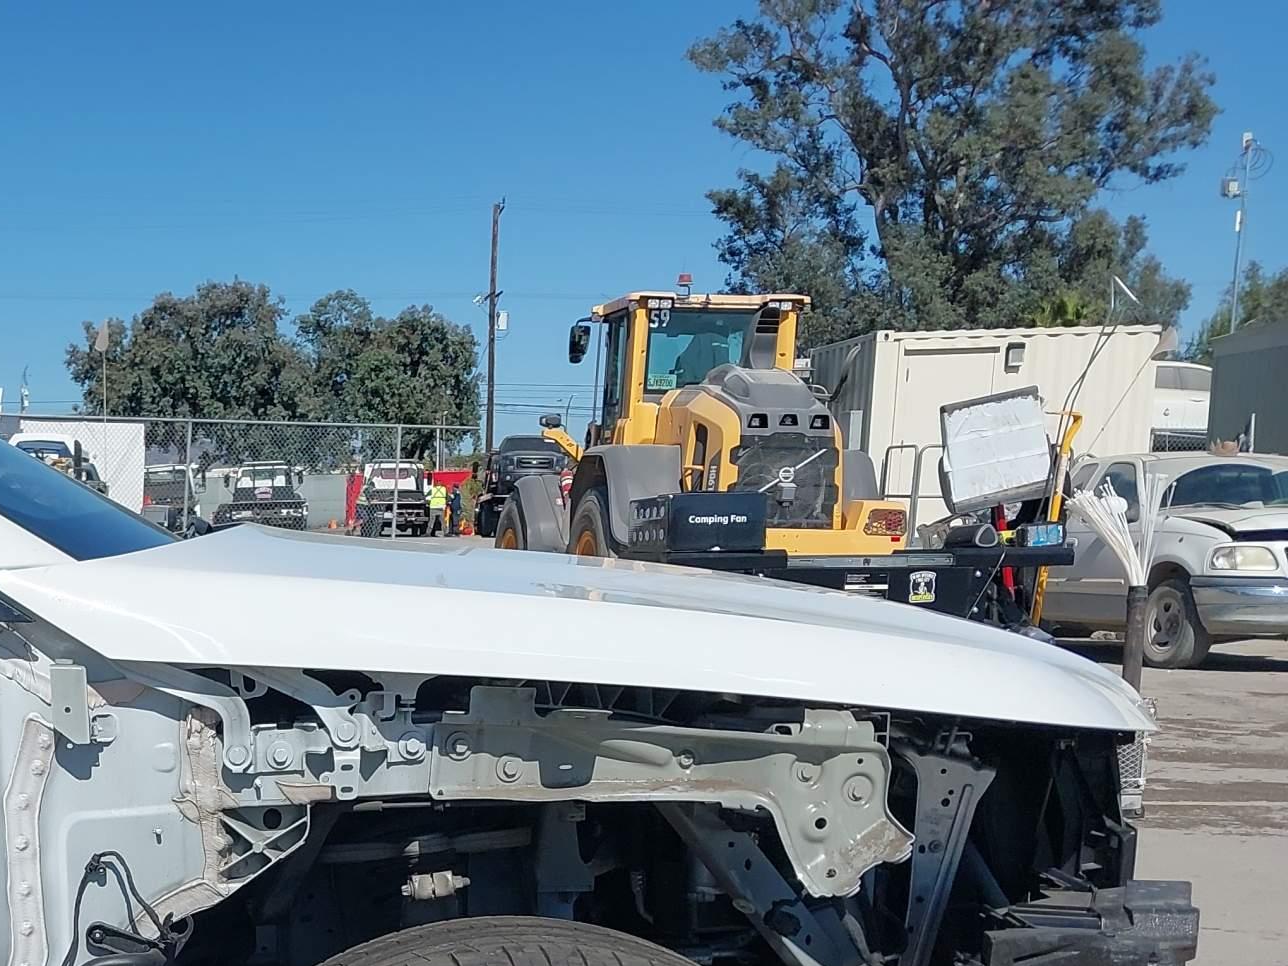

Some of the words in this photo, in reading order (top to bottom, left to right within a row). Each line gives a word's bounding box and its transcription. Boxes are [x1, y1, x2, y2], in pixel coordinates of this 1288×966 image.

[649, 309, 671, 328] 59
[688, 514, 729, 526] Camping
[730, 514, 748, 523] Fan
